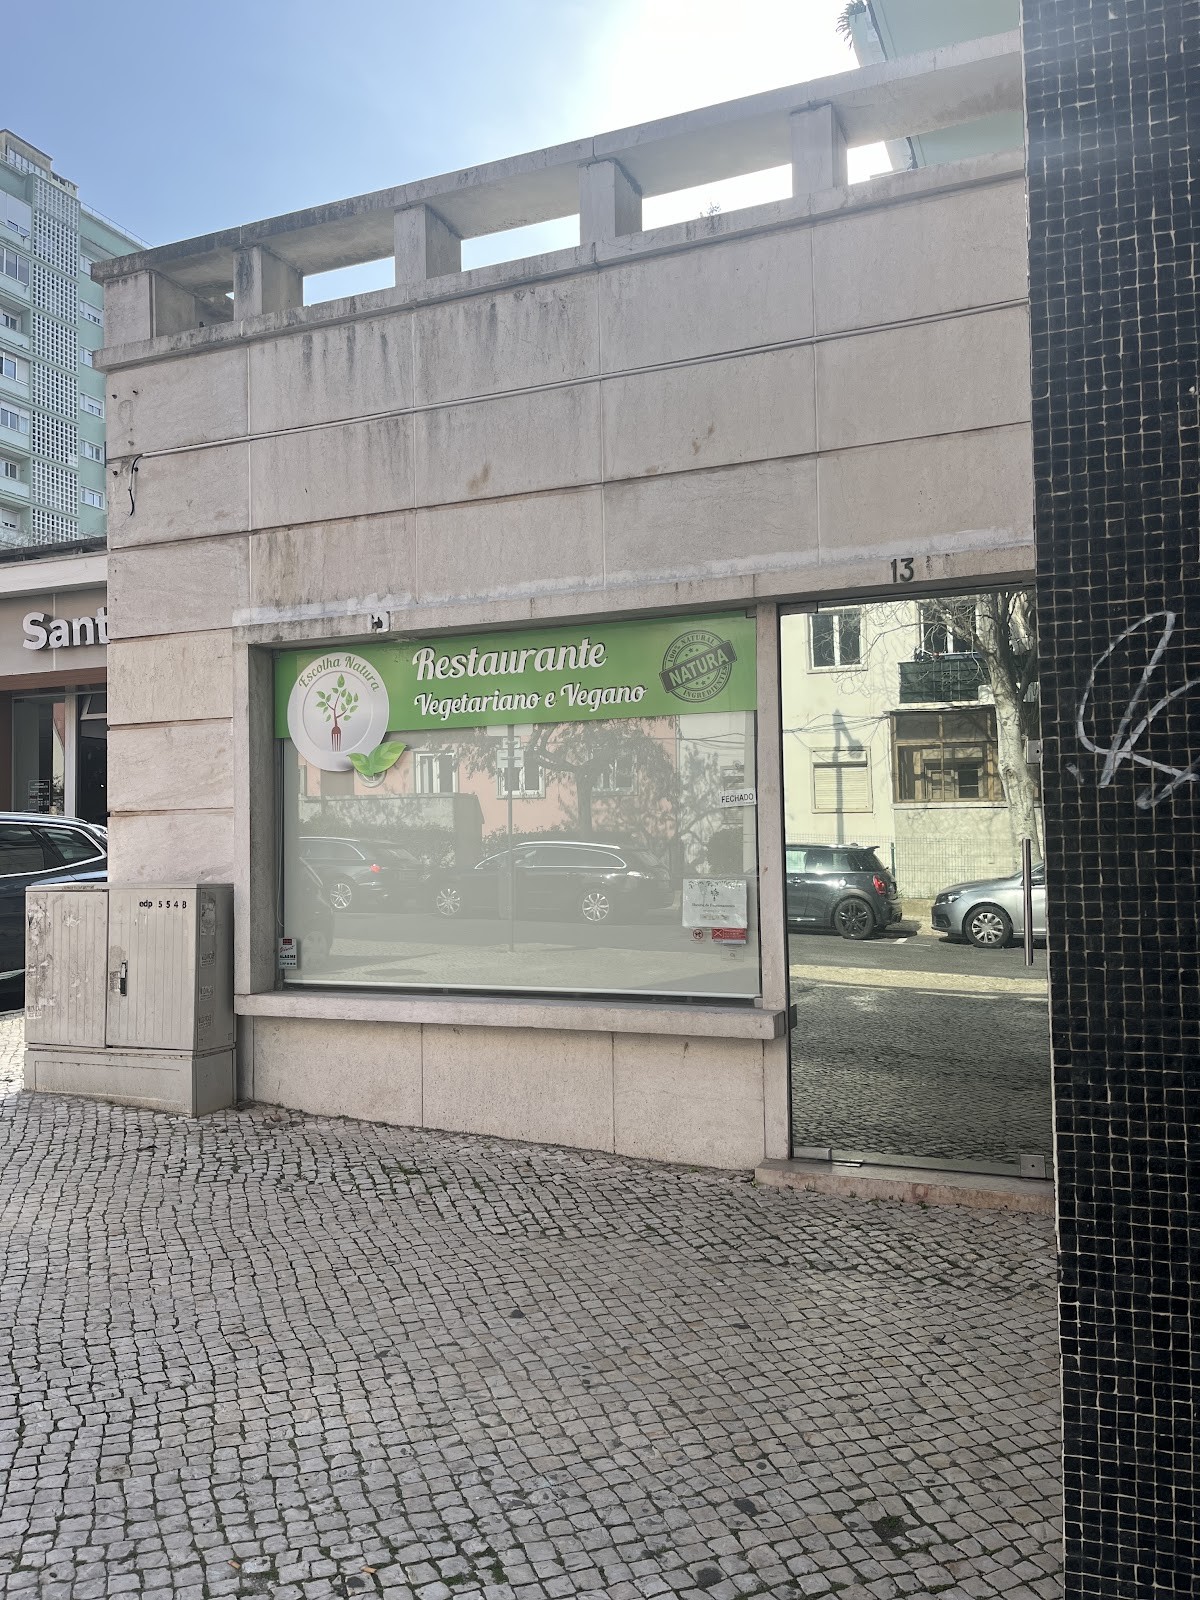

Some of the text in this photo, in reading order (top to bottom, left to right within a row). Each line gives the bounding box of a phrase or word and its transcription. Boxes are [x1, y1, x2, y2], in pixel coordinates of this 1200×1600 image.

[890, 557, 915, 583] 13
[22, 606, 110, 650] Sant
[298, 655, 380, 692] Escolha Natura
[412, 637, 608, 681] Restaurante
[668, 648, 730, 687] NATURA
[413, 682, 648, 721] Vegetariano e Vegano
[721, 792, 754, 803] FECHADO
